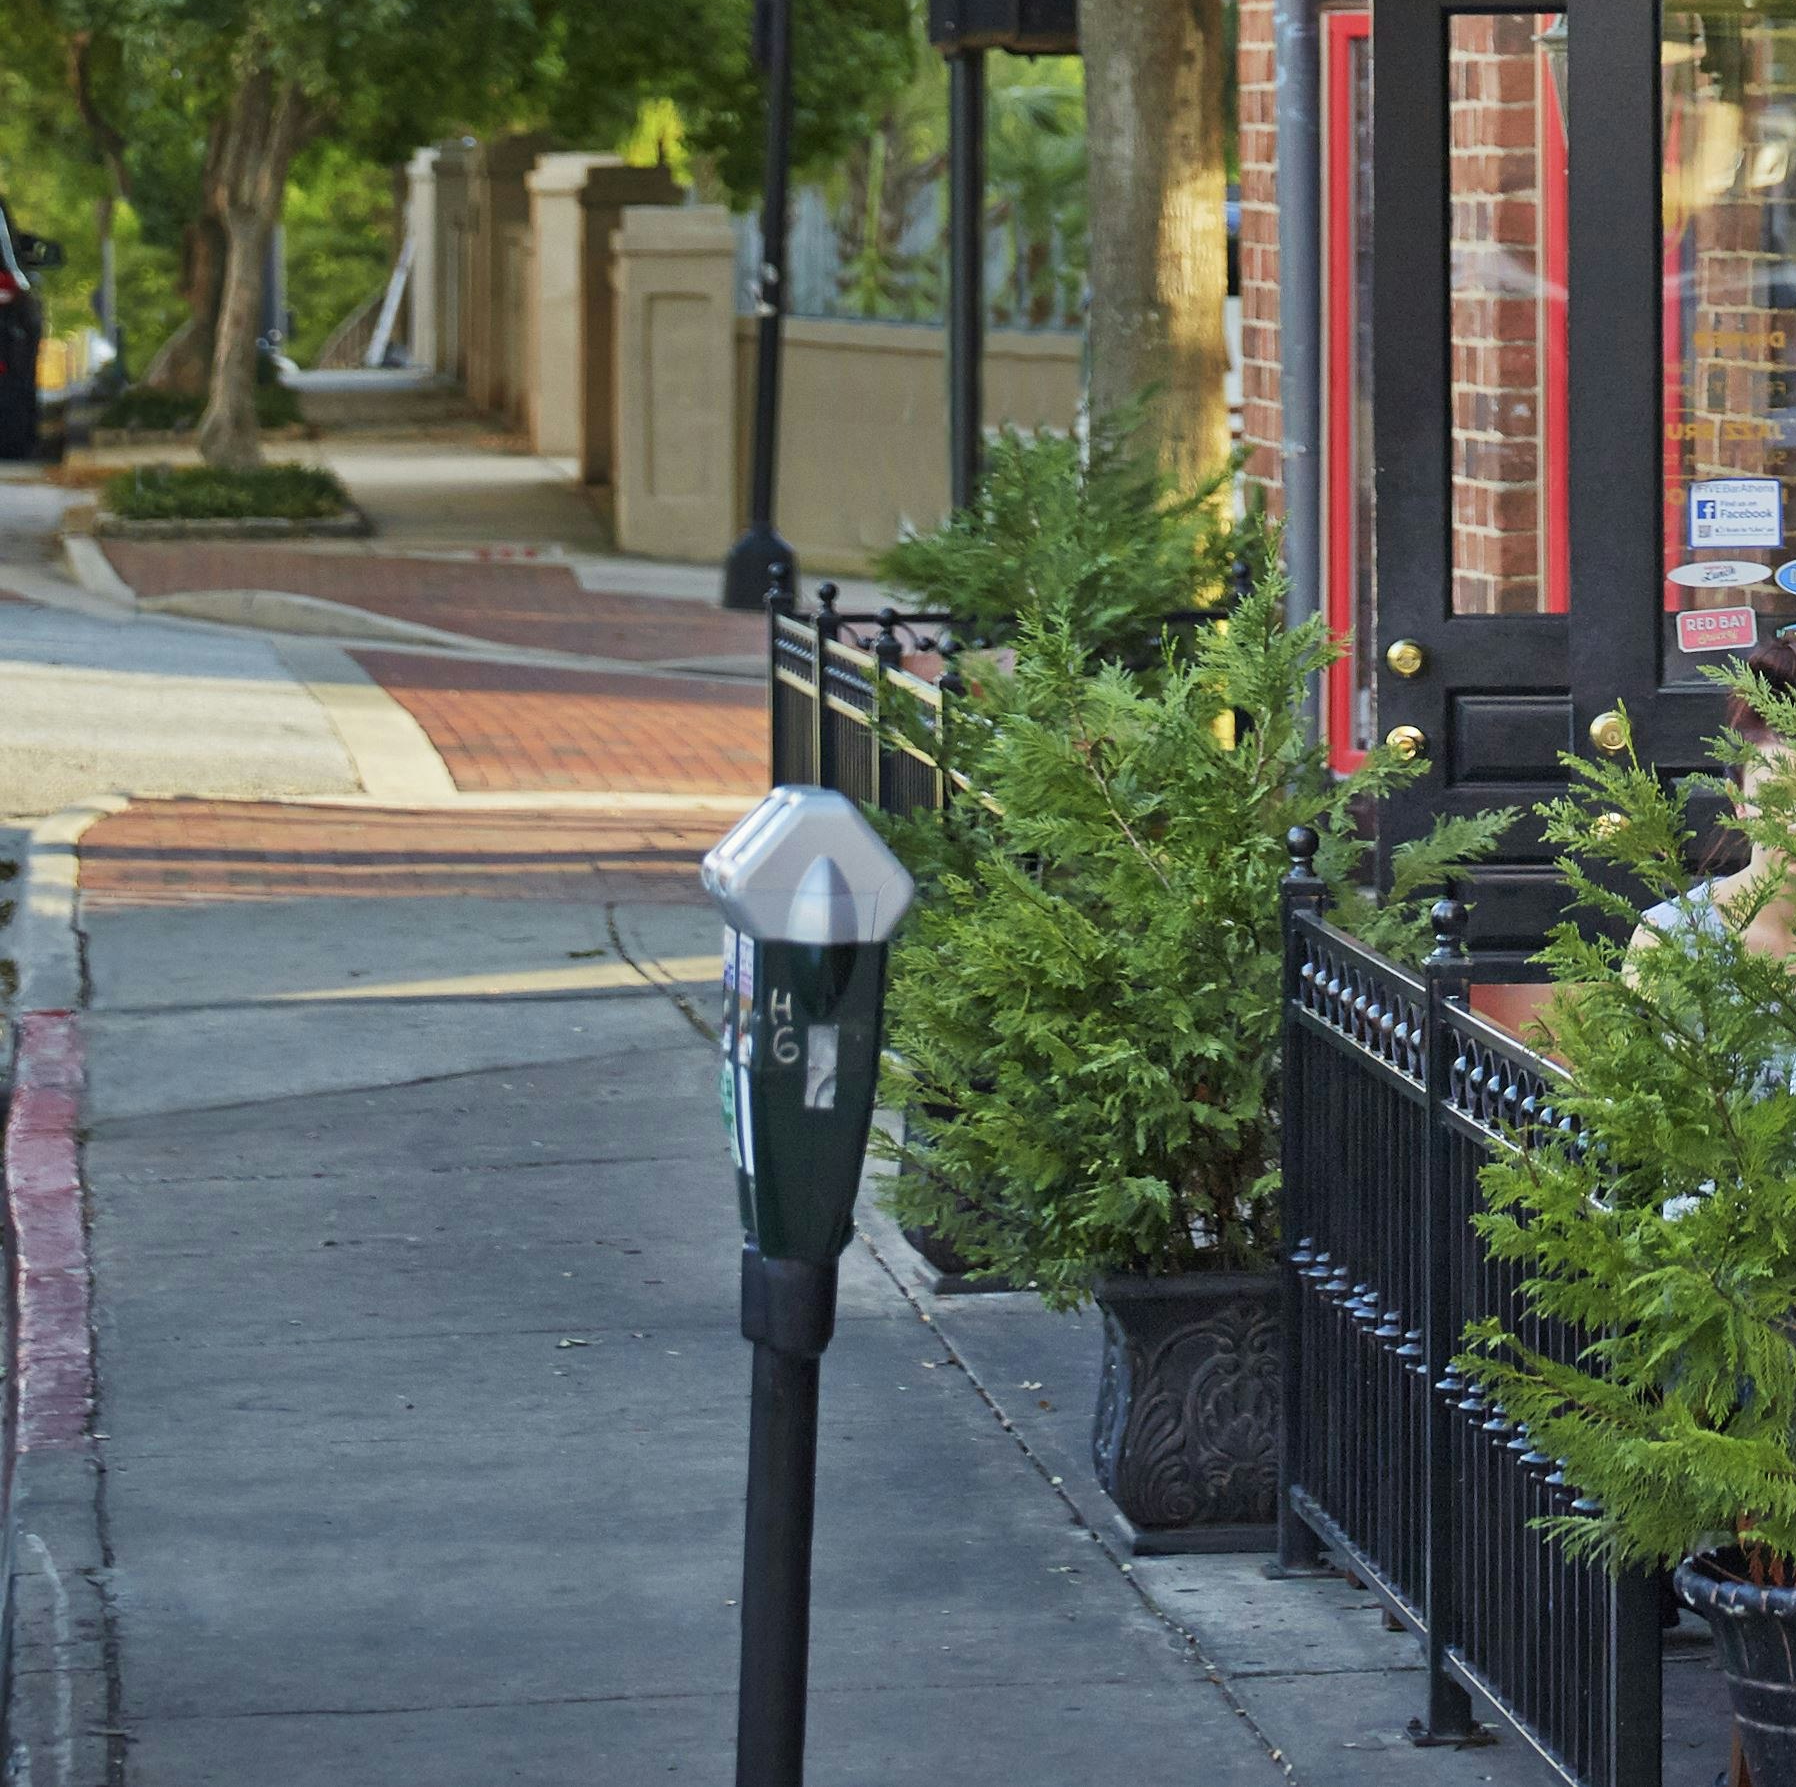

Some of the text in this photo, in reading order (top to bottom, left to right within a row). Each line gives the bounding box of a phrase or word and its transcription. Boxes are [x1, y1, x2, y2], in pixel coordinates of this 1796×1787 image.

[1720, 508, 1774, 519] Facebook
[1685, 613, 1747, 631] RED BAY
[770, 987, 793, 1025] H
